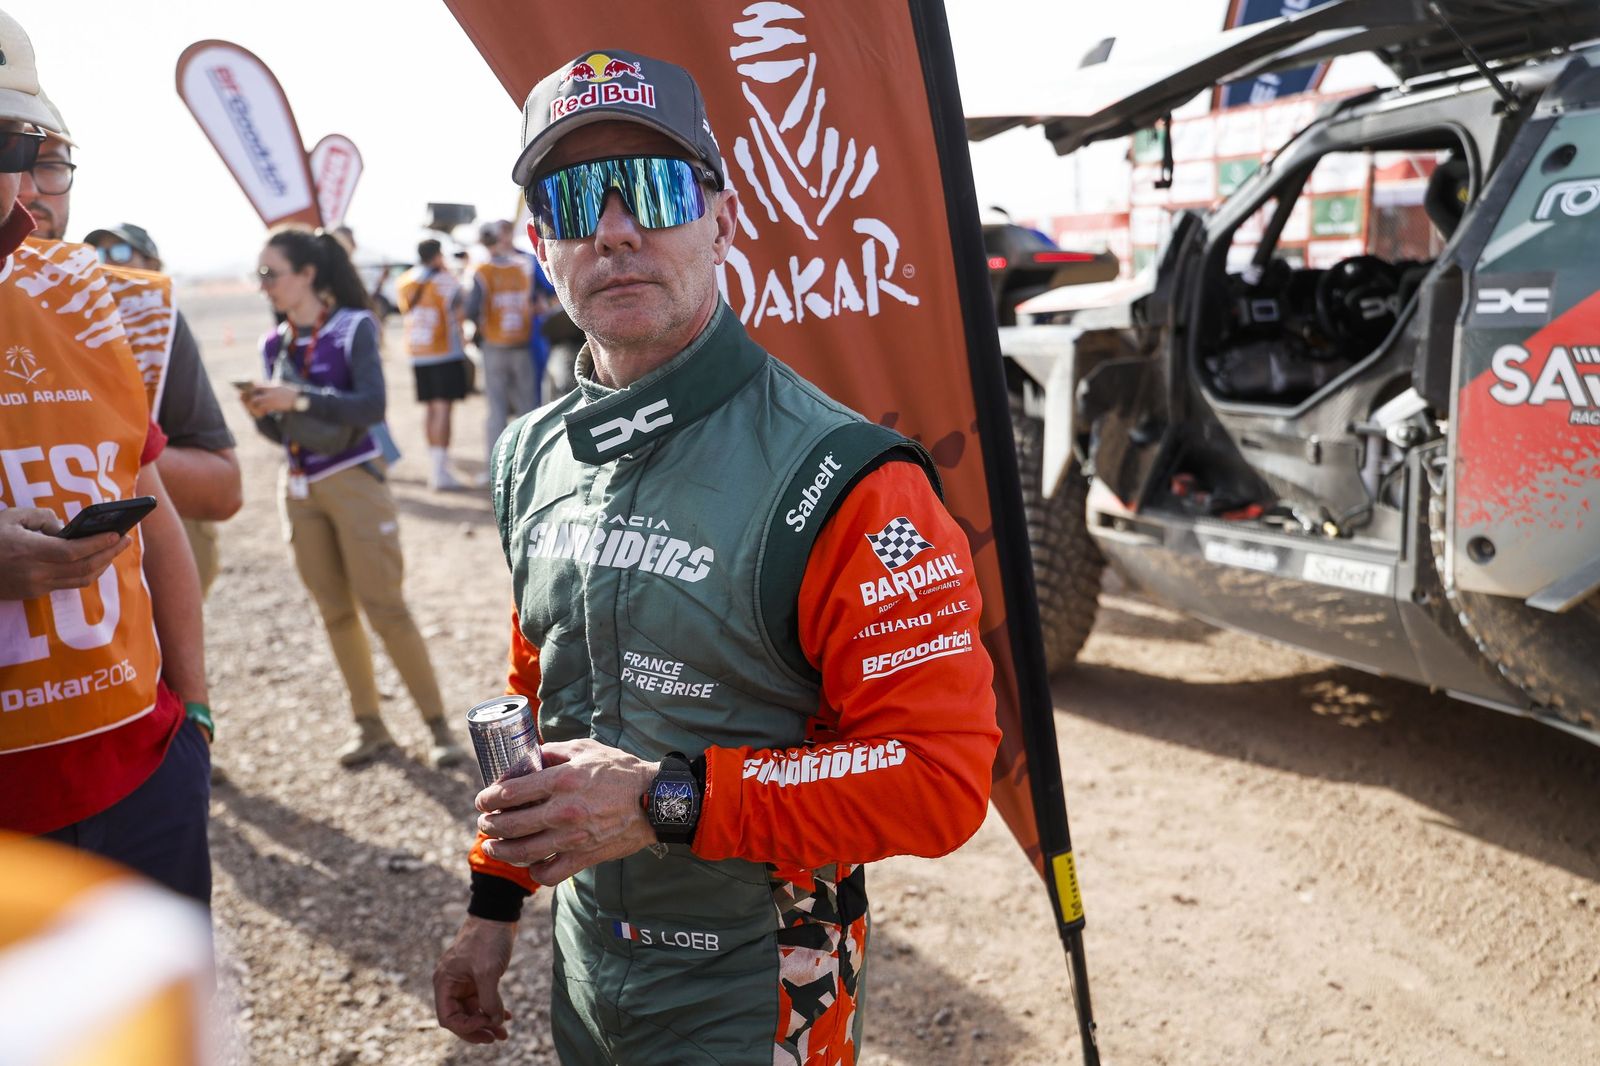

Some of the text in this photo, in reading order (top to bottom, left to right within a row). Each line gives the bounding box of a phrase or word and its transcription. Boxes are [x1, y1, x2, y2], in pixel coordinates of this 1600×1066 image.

[551, 81, 656, 120] Red Bull
[716, 218, 920, 329] DAKAR
[33, 389, 93, 403] ARABIA
[785, 451, 842, 533] Sabelt
[859, 554, 963, 606] BARDAHL
[623, 651, 684, 676] FRANCE
[862, 630, 972, 676] BFGoodrich
[661, 931, 719, 951] LOEB
